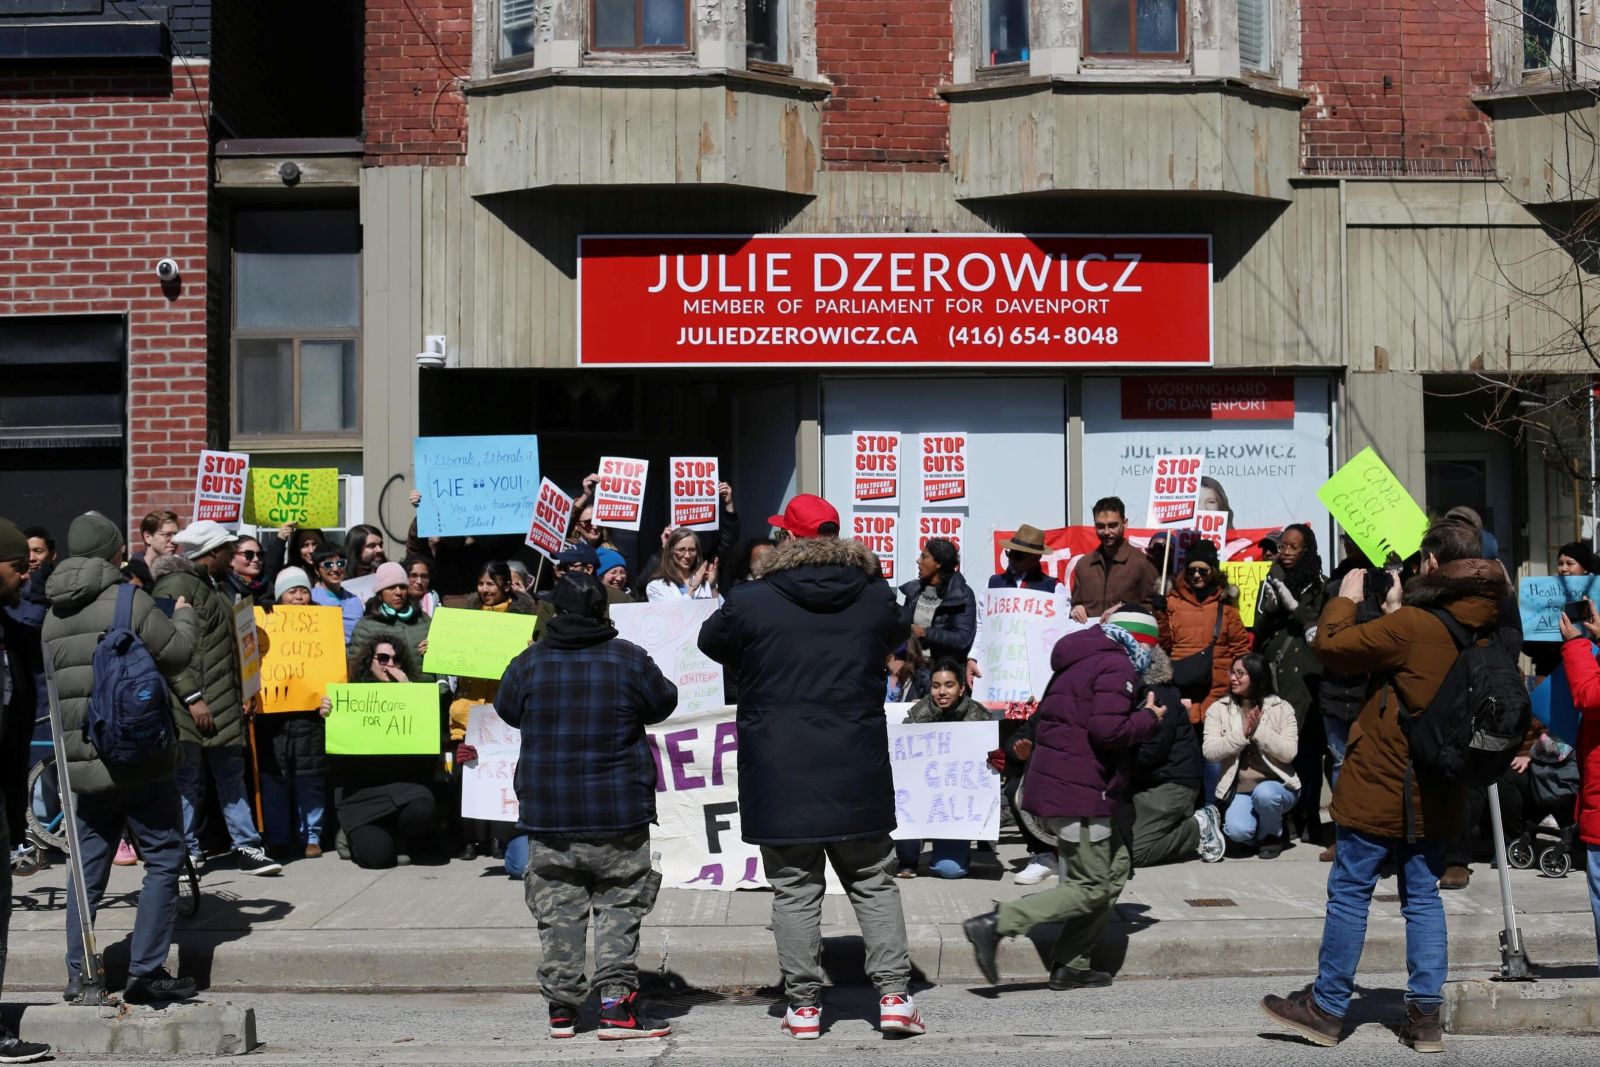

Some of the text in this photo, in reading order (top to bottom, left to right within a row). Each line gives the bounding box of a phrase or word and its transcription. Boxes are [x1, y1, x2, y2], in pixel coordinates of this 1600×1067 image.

[647, 252, 1143, 294] JULIE DZEROWICZ
[683, 298, 1110, 314] MEMBER OF PARLIAMENT FOR DAVENPORT
[676, 326, 918, 346] JULIEDZEROWICZ.CA
[948, 325, 1004, 350] (416)
[1148, 383, 1267, 396] WORKING HARD
[1147, 398, 1267, 411] FOR DAVENPORT
[857, 435, 898, 452] STOP
[924, 437, 964, 454] STOP
[205, 455, 246, 475] STOP
[603, 460, 645, 477] STOP
[675, 461, 716, 478] STOP
[856, 454, 897, 471] CUTS
[924, 455, 964, 472] CUTS
[1121, 464, 1297, 477] MEM PARLIAMENT
[1157, 458, 1200, 475] STOP
[201, 475, 243, 495] CUTS
[269, 474, 309, 490] CARE
[433, 478, 464, 498] WE
[600, 476, 642, 496] CUTS
[674, 480, 716, 496] CUTS
[1155, 477, 1197, 494] CUTS
[1363, 466, 1402, 508] CARE
[277, 492, 309, 506] NOT
[541, 484, 570, 515] STOP
[1351, 486, 1385, 516] NOT
[269, 509, 309, 523] CUTS
[536, 501, 565, 533] CUTS
[1195, 514, 1224, 532] TOP
[854, 517, 895, 533] STOP
[920, 517, 961, 534] STOP
[281, 640, 324, 658] CUTS
[336, 690, 406, 713] Healthcare
[386, 714, 413, 735] All
[892, 732, 952, 762] ALTH
[924, 761, 992, 790] CARE
